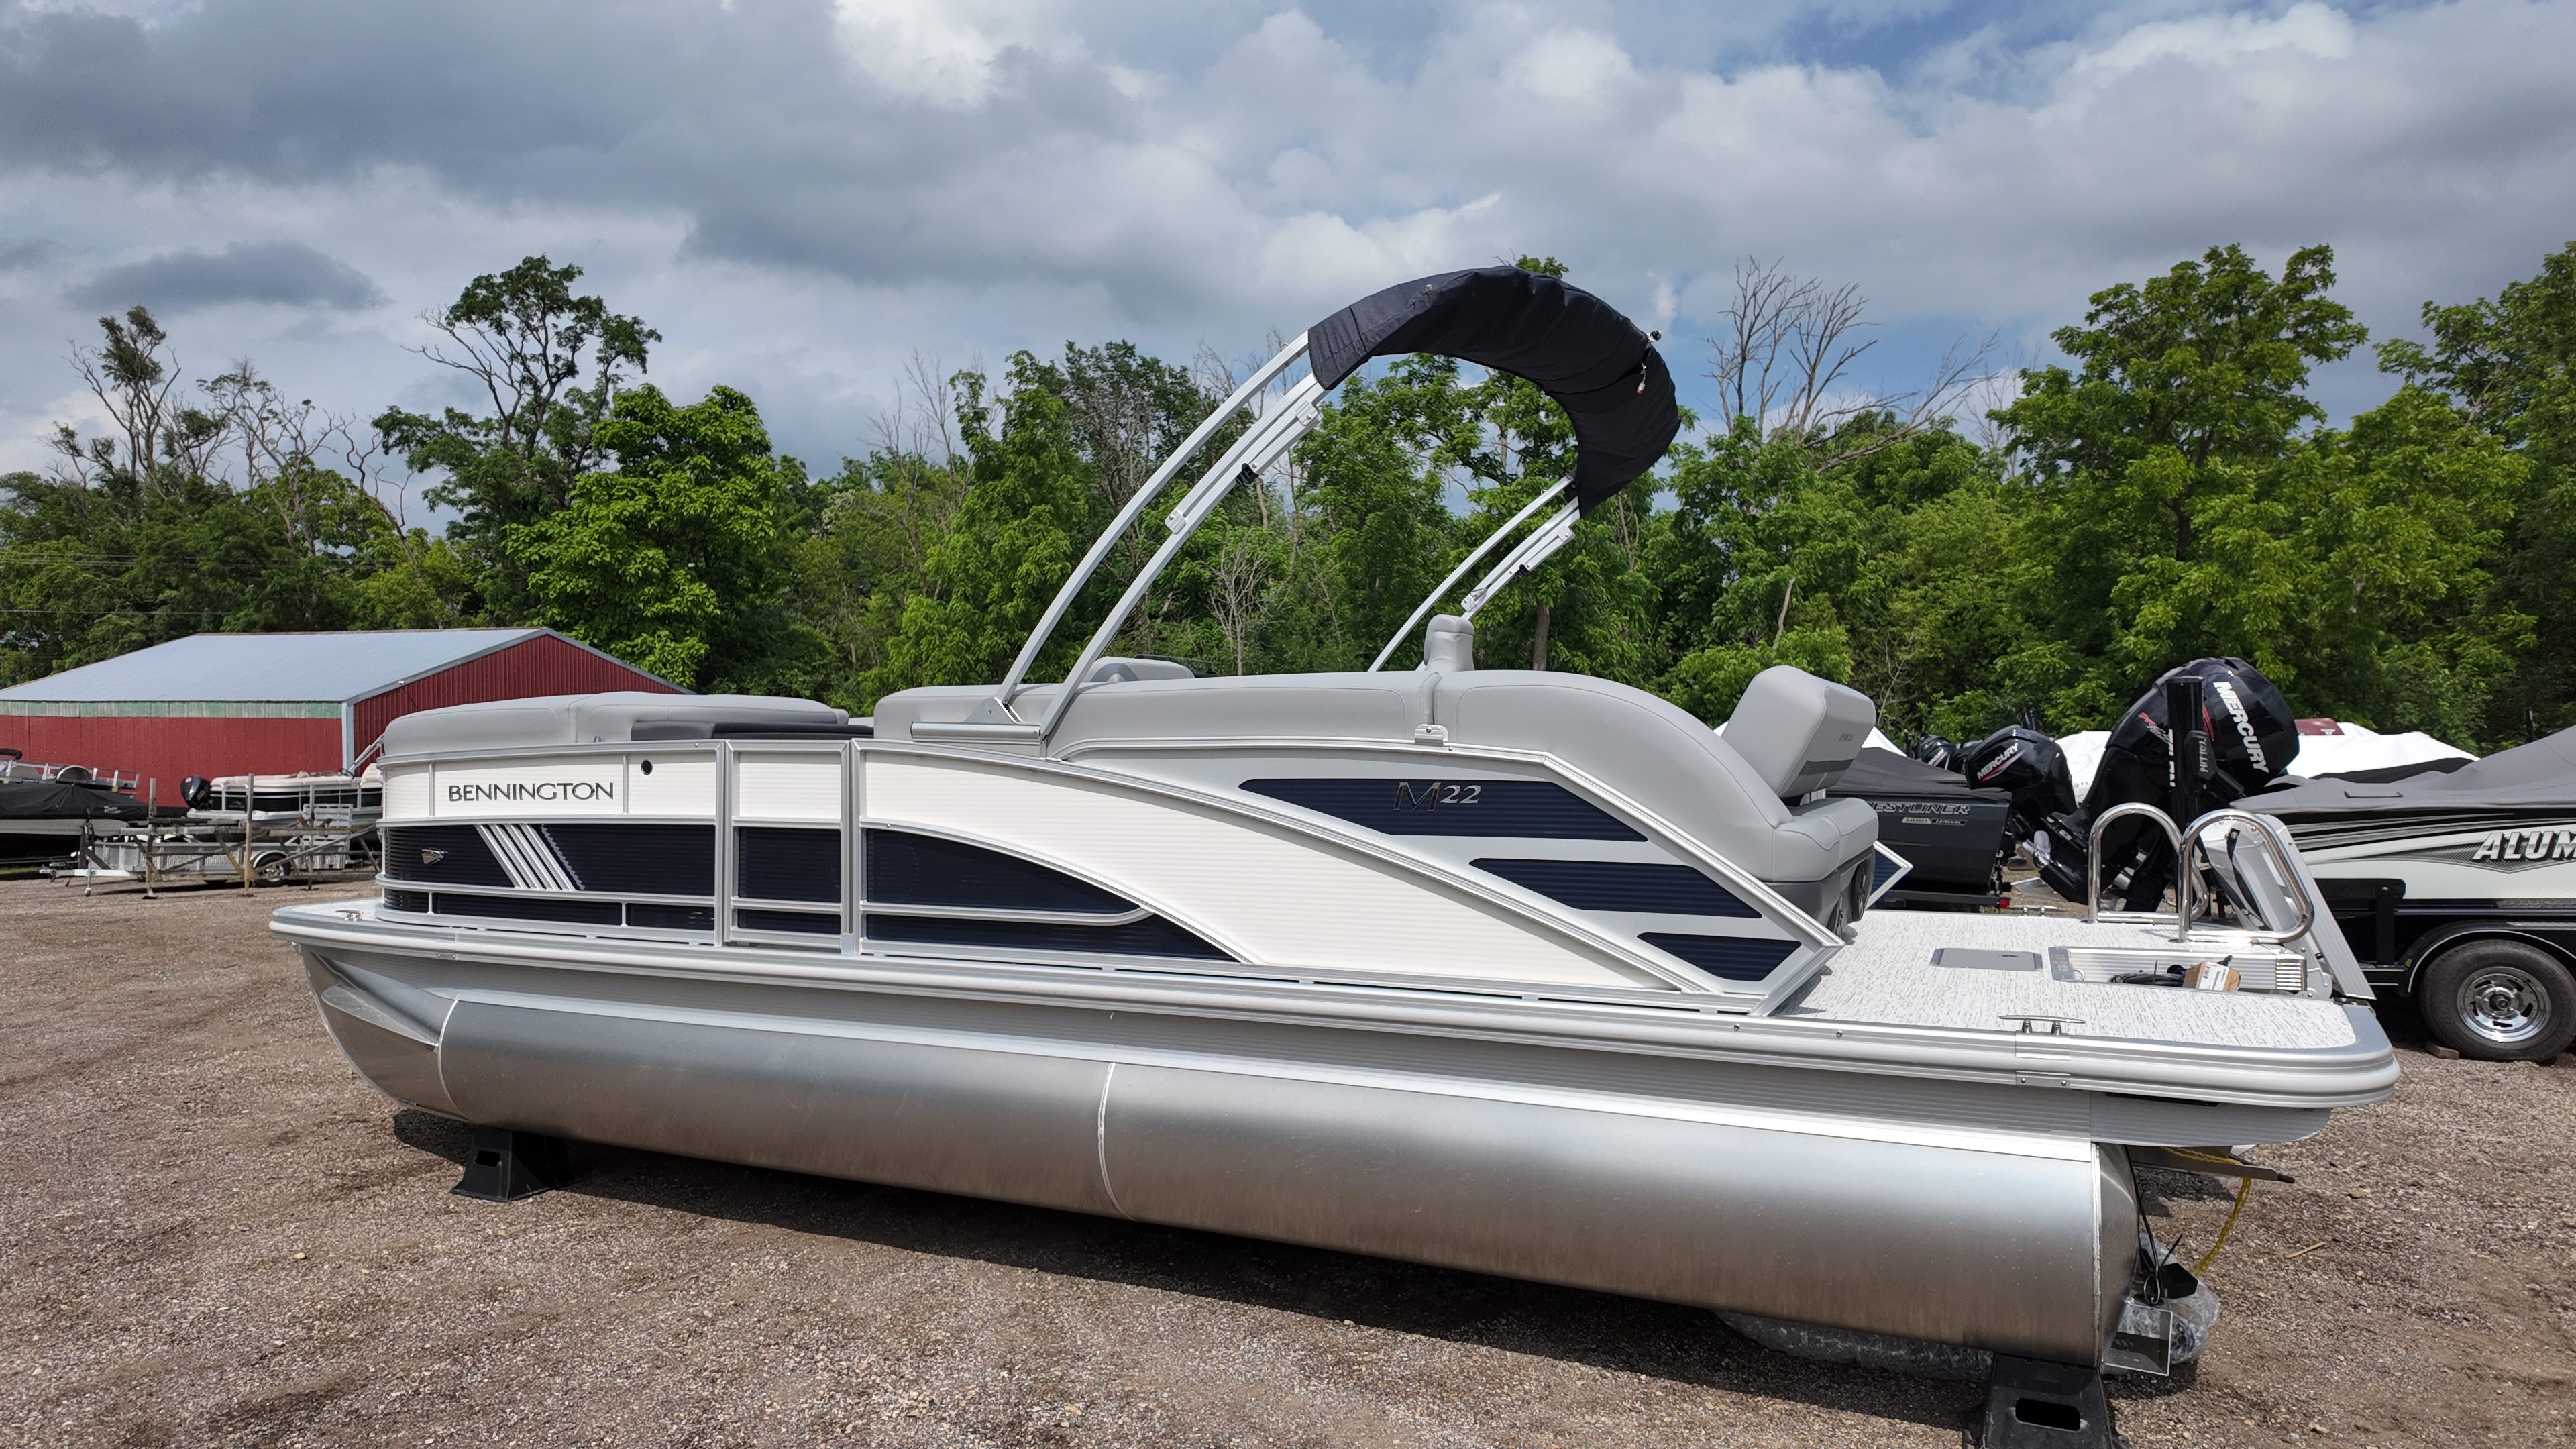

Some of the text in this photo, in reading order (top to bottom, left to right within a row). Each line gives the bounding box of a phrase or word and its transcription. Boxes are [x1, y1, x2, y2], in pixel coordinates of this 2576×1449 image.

[2213, 682, 2269, 773] MERCURY
[1977, 742, 2019, 780] MERCURY
[449, 782, 614, 802] BENNINGTON
[1393, 782, 1481, 812] M22
[1868, 802, 1970, 814] ESTLINER
[2471, 830, 2576, 860] ALUM
